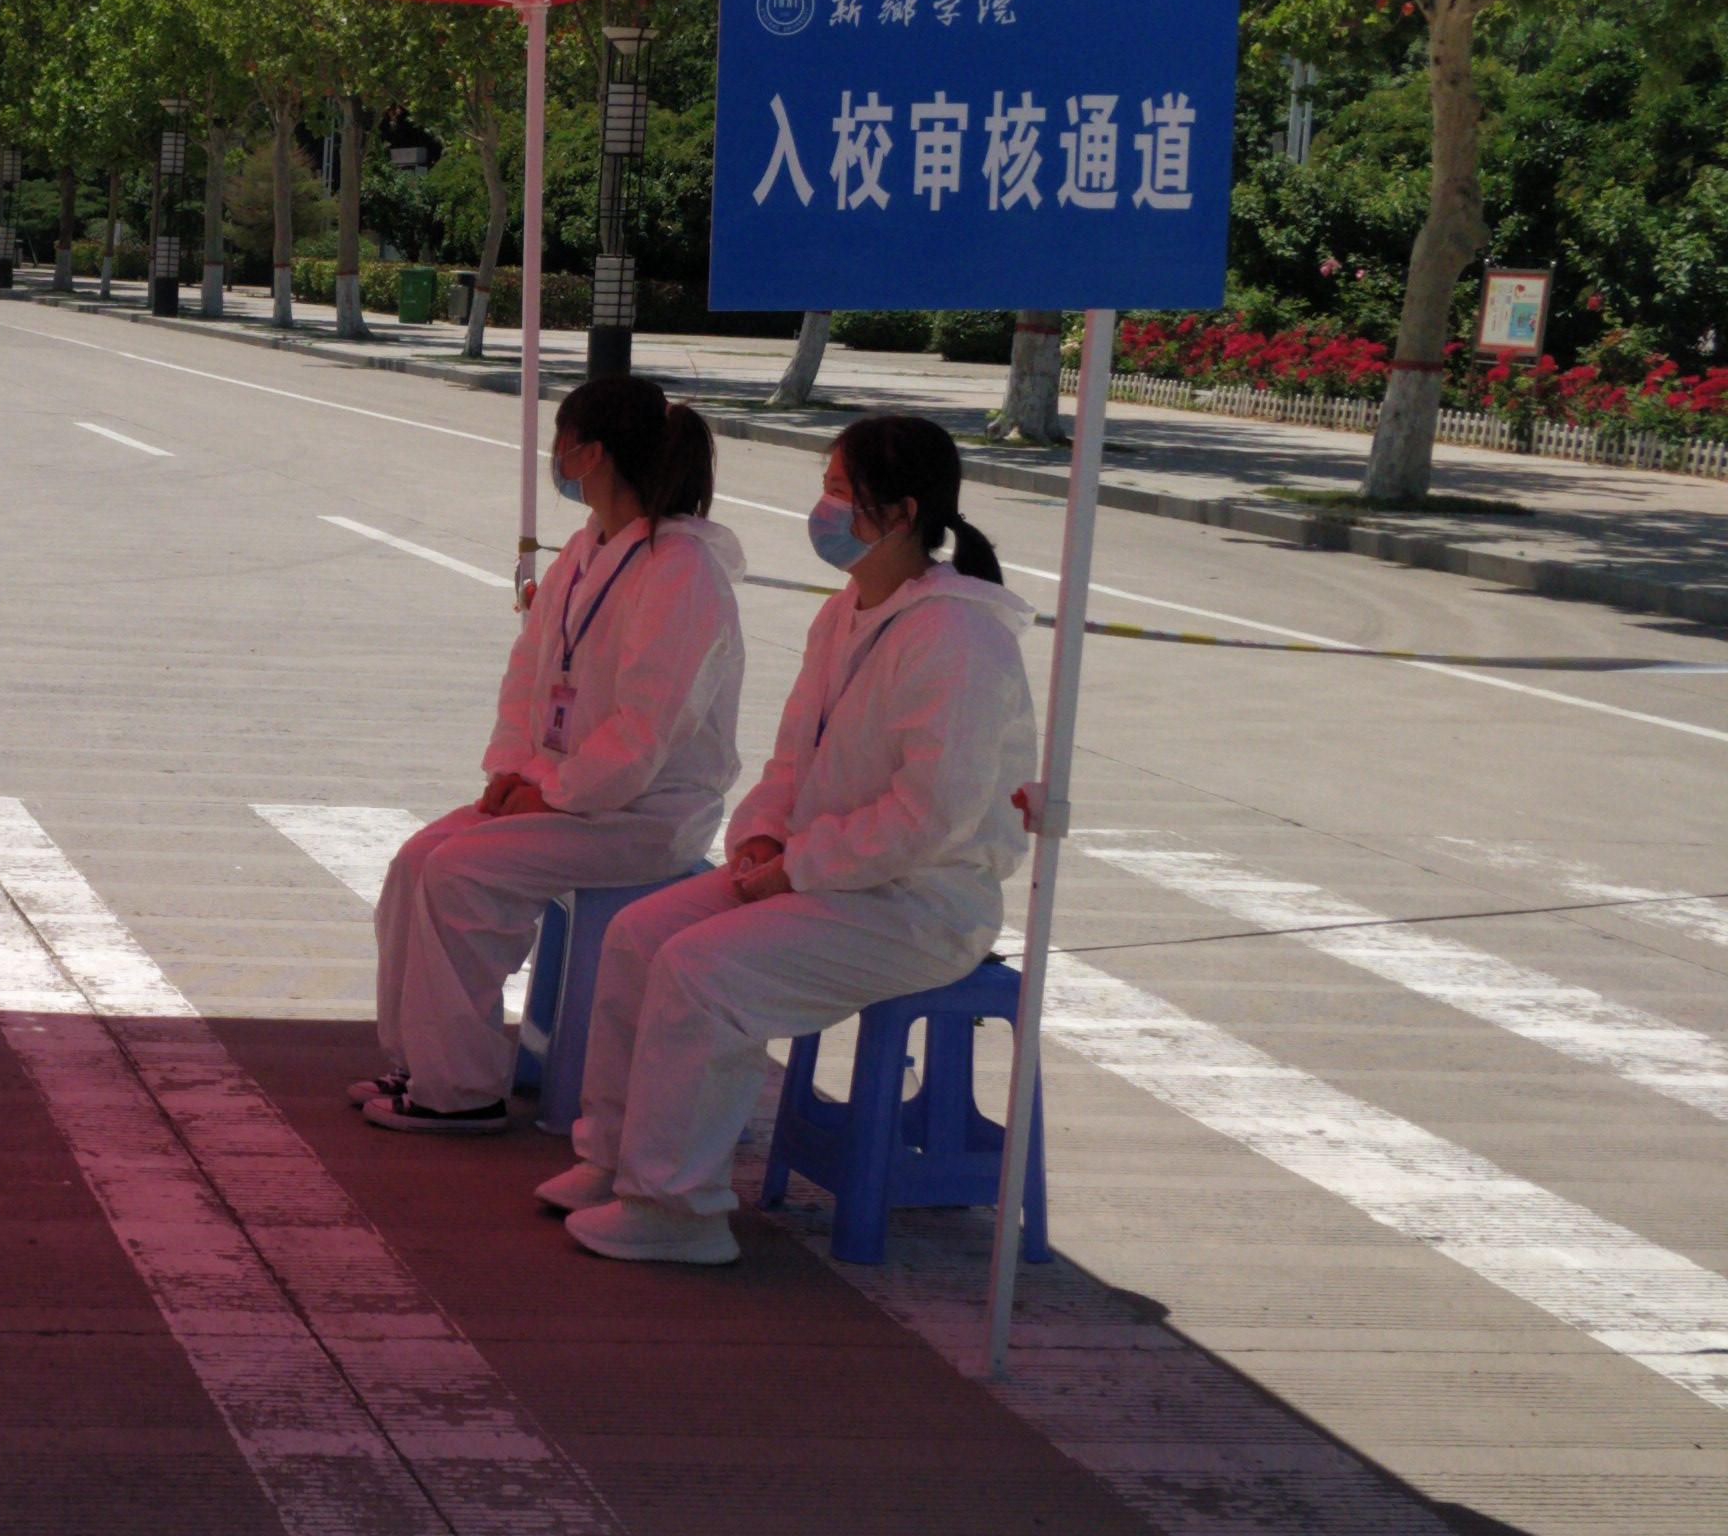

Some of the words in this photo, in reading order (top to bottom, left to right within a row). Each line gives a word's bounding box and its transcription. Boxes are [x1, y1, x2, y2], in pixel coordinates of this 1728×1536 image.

[753, 91, 1195, 211] 入校审核通道
